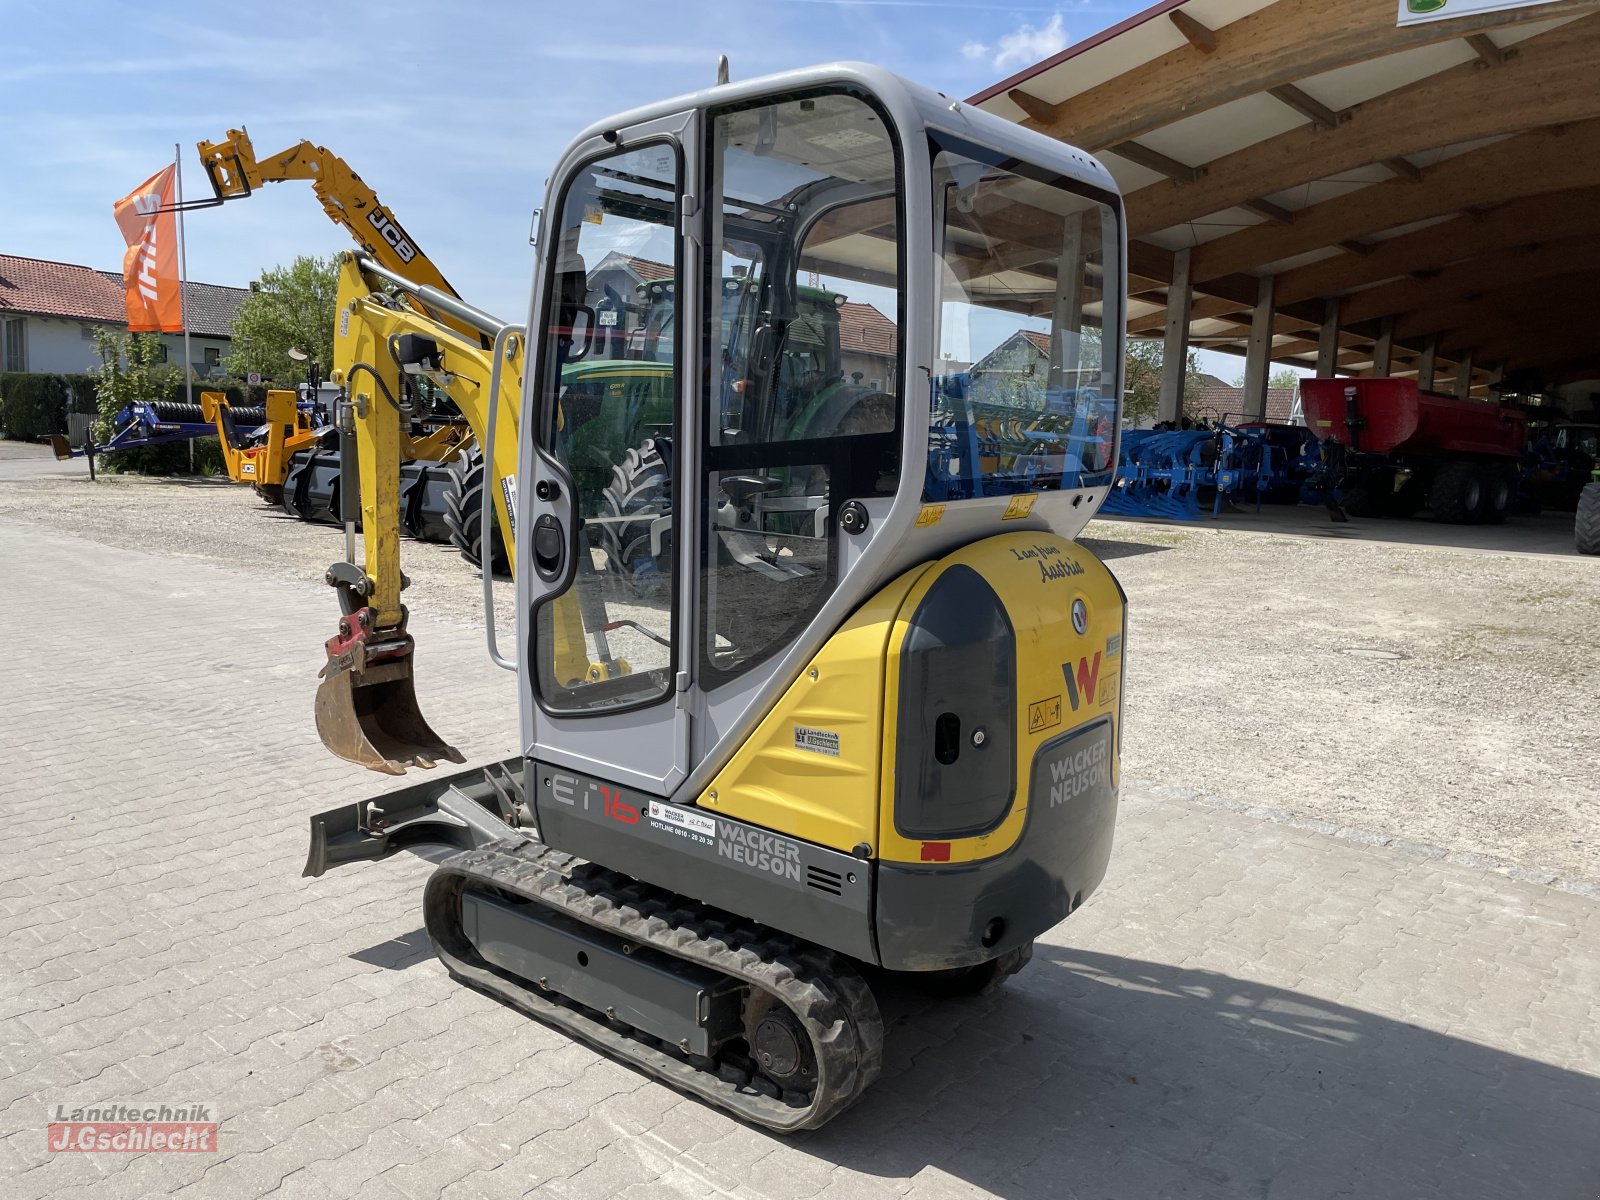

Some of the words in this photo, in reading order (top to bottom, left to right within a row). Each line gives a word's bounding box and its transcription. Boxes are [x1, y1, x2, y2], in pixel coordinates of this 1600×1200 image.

[368, 212, 415, 263] JCB
[242, 463, 255, 474] JCB
[1009, 548, 1024, 560] I
[1022, 549, 1039, 558] am
[1032, 544, 1061, 560] from
[1038, 556, 1085, 583] Austria
[1050, 739, 1106, 783] WACKER
[1050, 760, 1106, 808] NEUSON
[664, 808, 684, 818] WACKER
[664, 813, 685, 824] NEUSON
[650, 820, 674, 833] HOTLINE
[674, 828, 688, 838] 0810
[699, 836, 706, 844] 20
[706, 838, 714, 846] 30
[717, 820, 800, 863] WACKER
[718, 838, 801, 882] NEUSON
